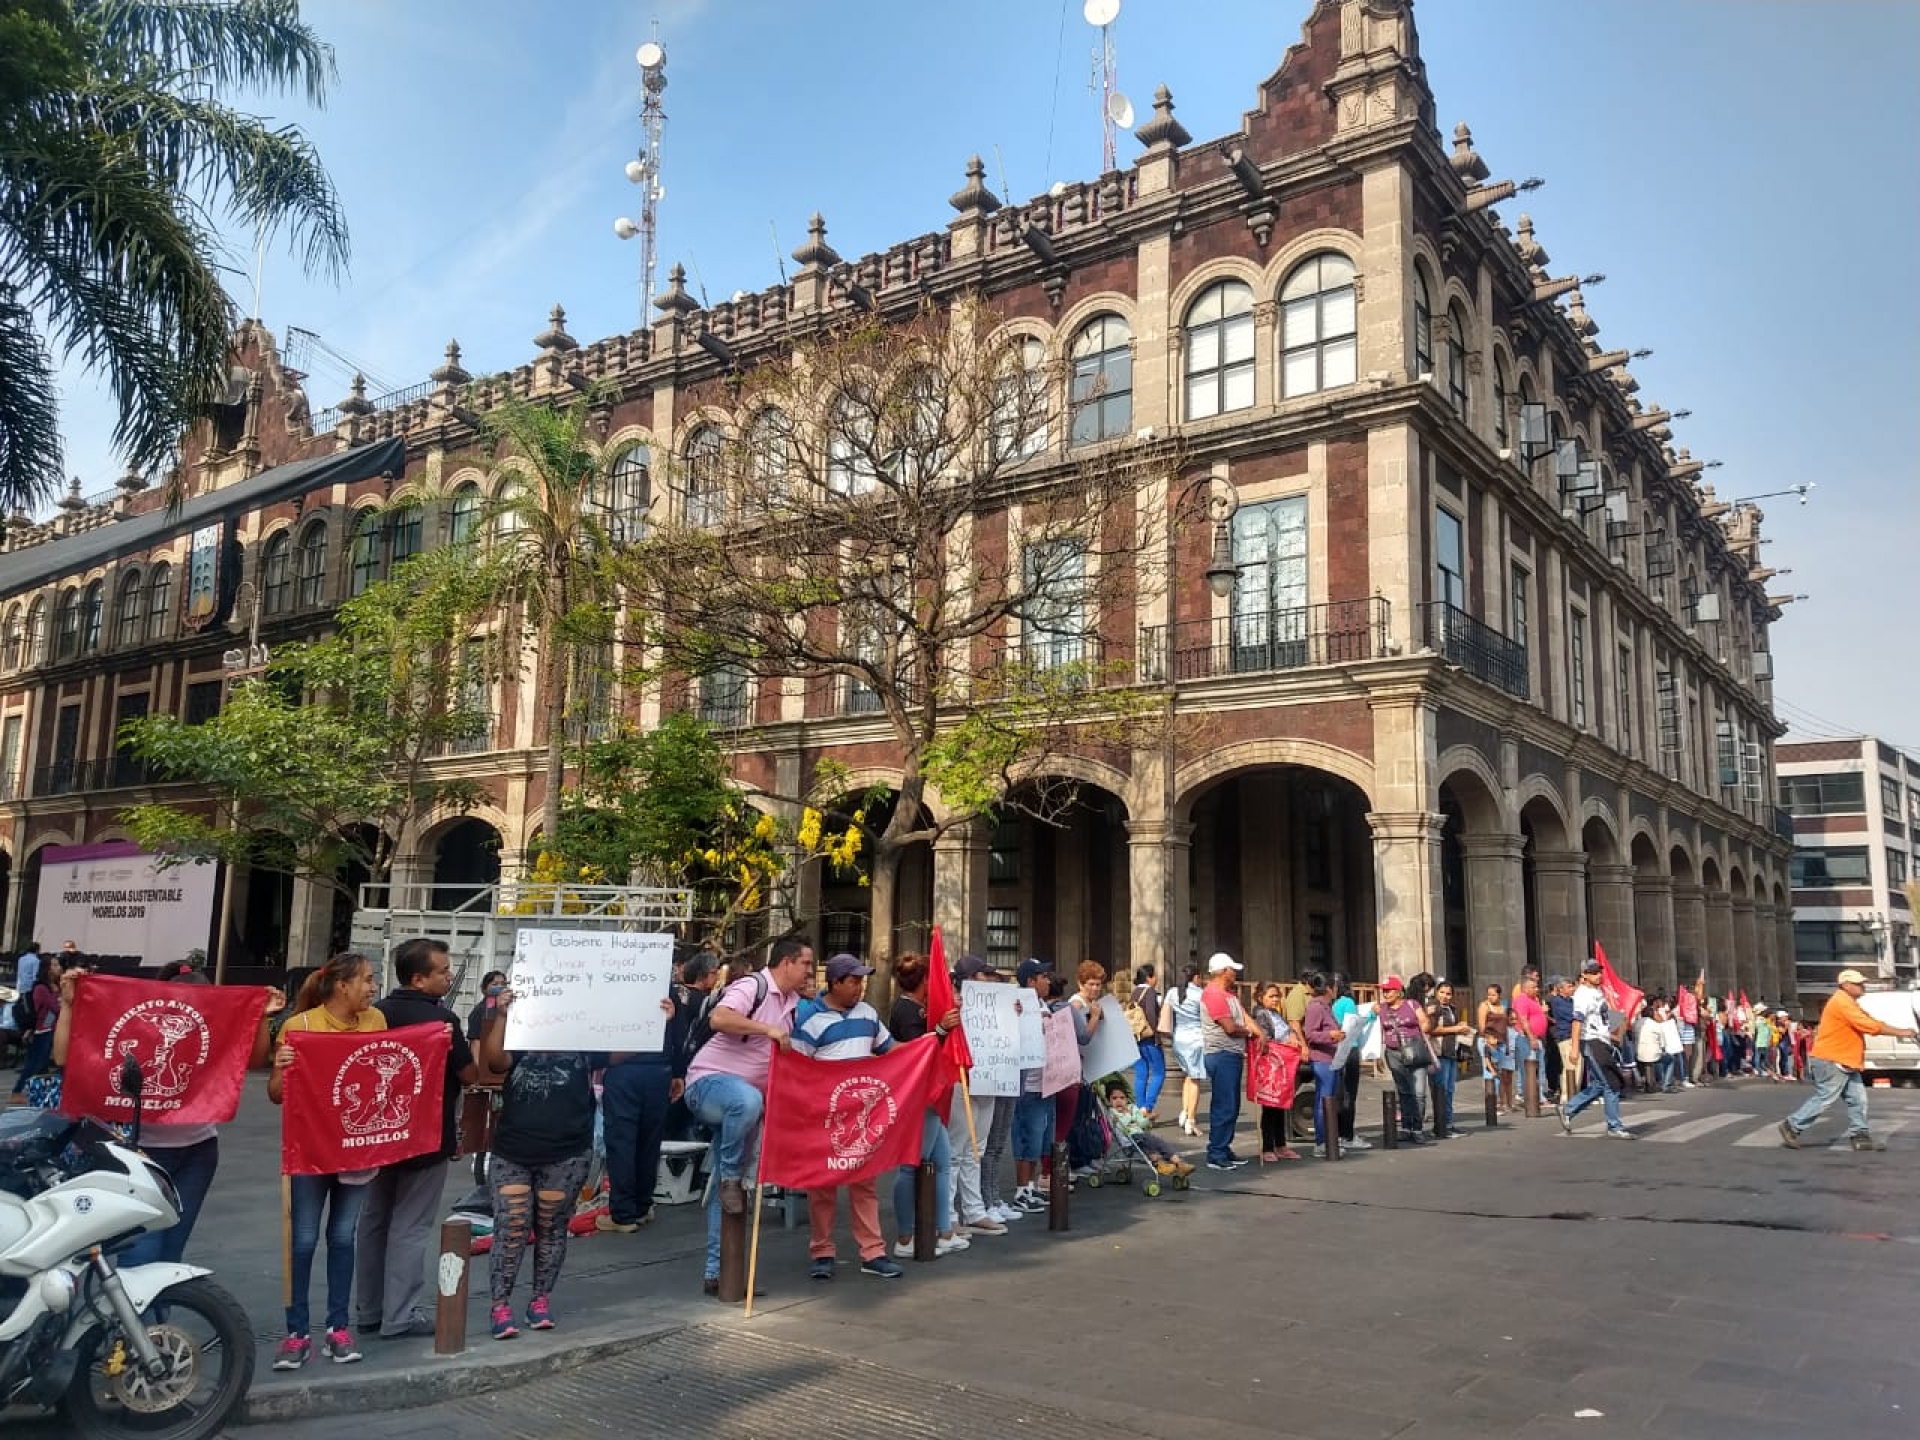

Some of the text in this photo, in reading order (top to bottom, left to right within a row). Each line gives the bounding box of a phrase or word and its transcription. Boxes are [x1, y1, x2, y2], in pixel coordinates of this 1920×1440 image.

[83, 890, 92, 904] DE
[93, 890, 127, 903] VIVIENDA
[128, 888, 183, 902] SUSTENTABLE
[93, 905, 127, 919] MORELOS
[104, 999, 210, 1065] MOVIMIENTO ANTORCHISTA
[332, 1040, 423, 1107] MOVIMIENTO ANTORCHISTA
[104, 1096, 182, 1110] MOELOS
[342, 1129, 410, 1149] MORELOS
